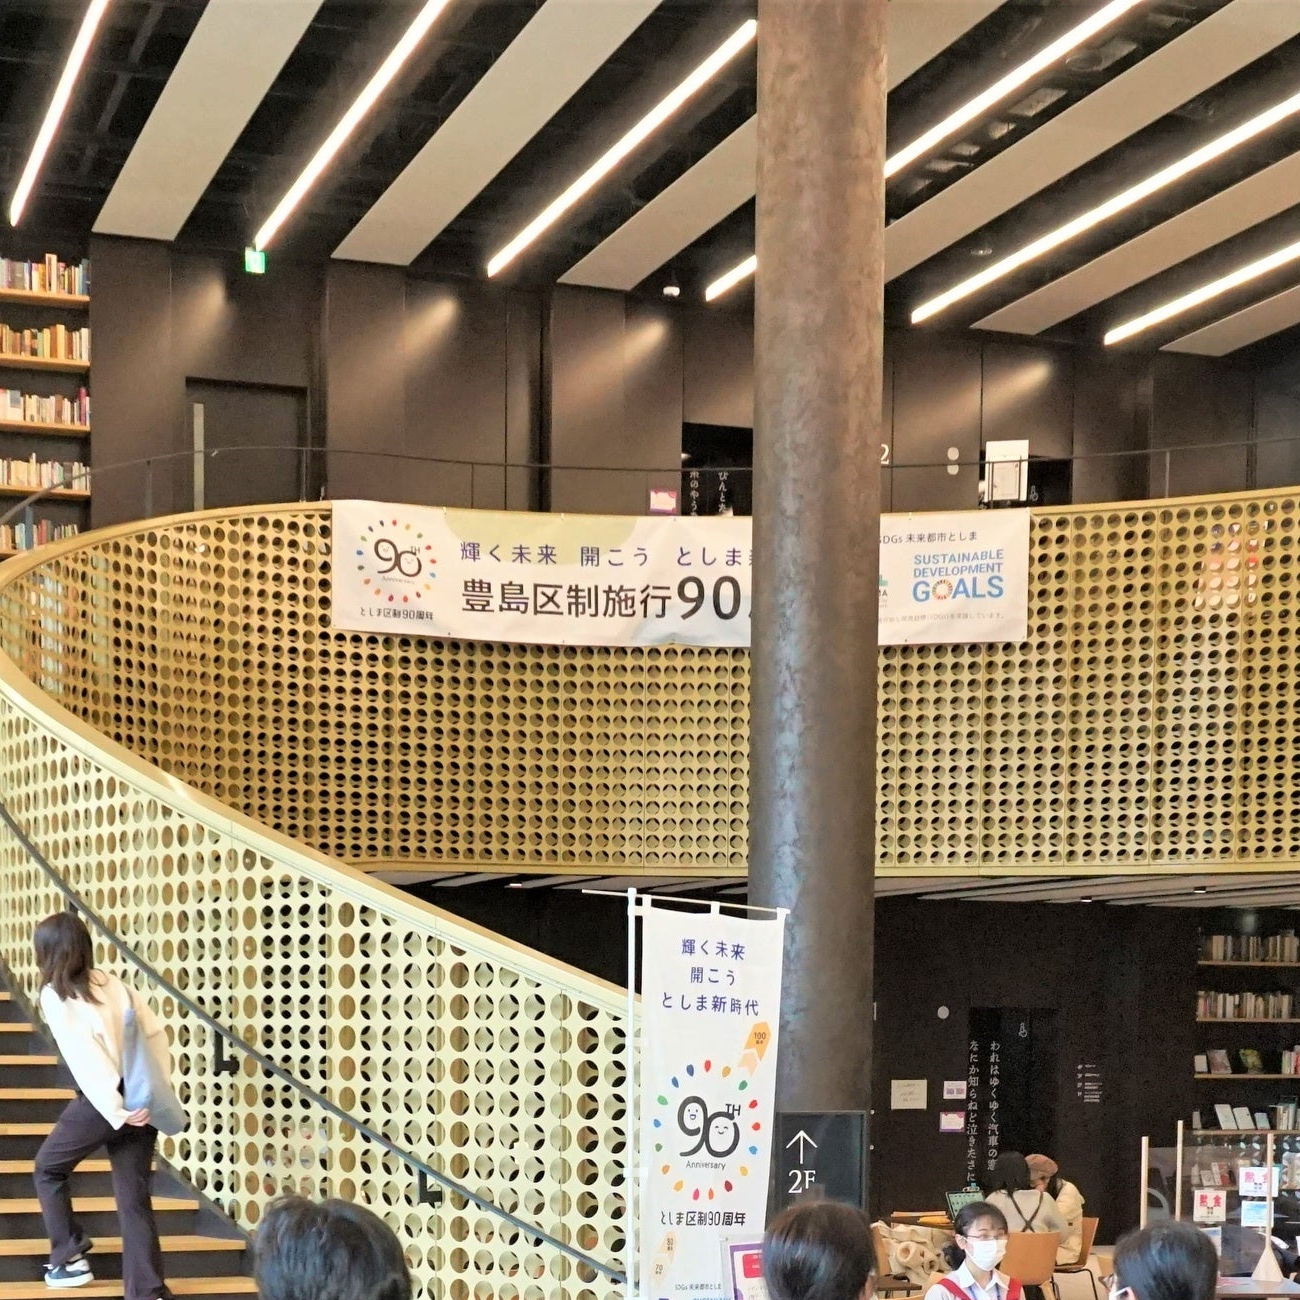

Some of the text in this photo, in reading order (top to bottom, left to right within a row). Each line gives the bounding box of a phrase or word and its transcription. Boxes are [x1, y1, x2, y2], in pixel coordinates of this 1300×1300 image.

[906, 531, 978, 543] 未来都市としま
[460, 541, 753, 567] 輝く未来 開こう としま
[914, 549, 1004, 565] SUSTAINABLE
[913, 562, 1004, 578] DEVELOPMENT
[462, 575, 752, 621] 豊島区制施行90
[912, 575, 1004, 602] GOALS
[681, 938, 746, 960] 輝く未来
[690, 966, 735, 986] 開こう
[662, 992, 759, 1016] としま新時代
[754, 1031, 767, 1040] 100
[685, 1160, 726, 1170] Anniversary
[788, 1169, 816, 1194] 2F
[660, 1210, 746, 1227] としま区制90周年
